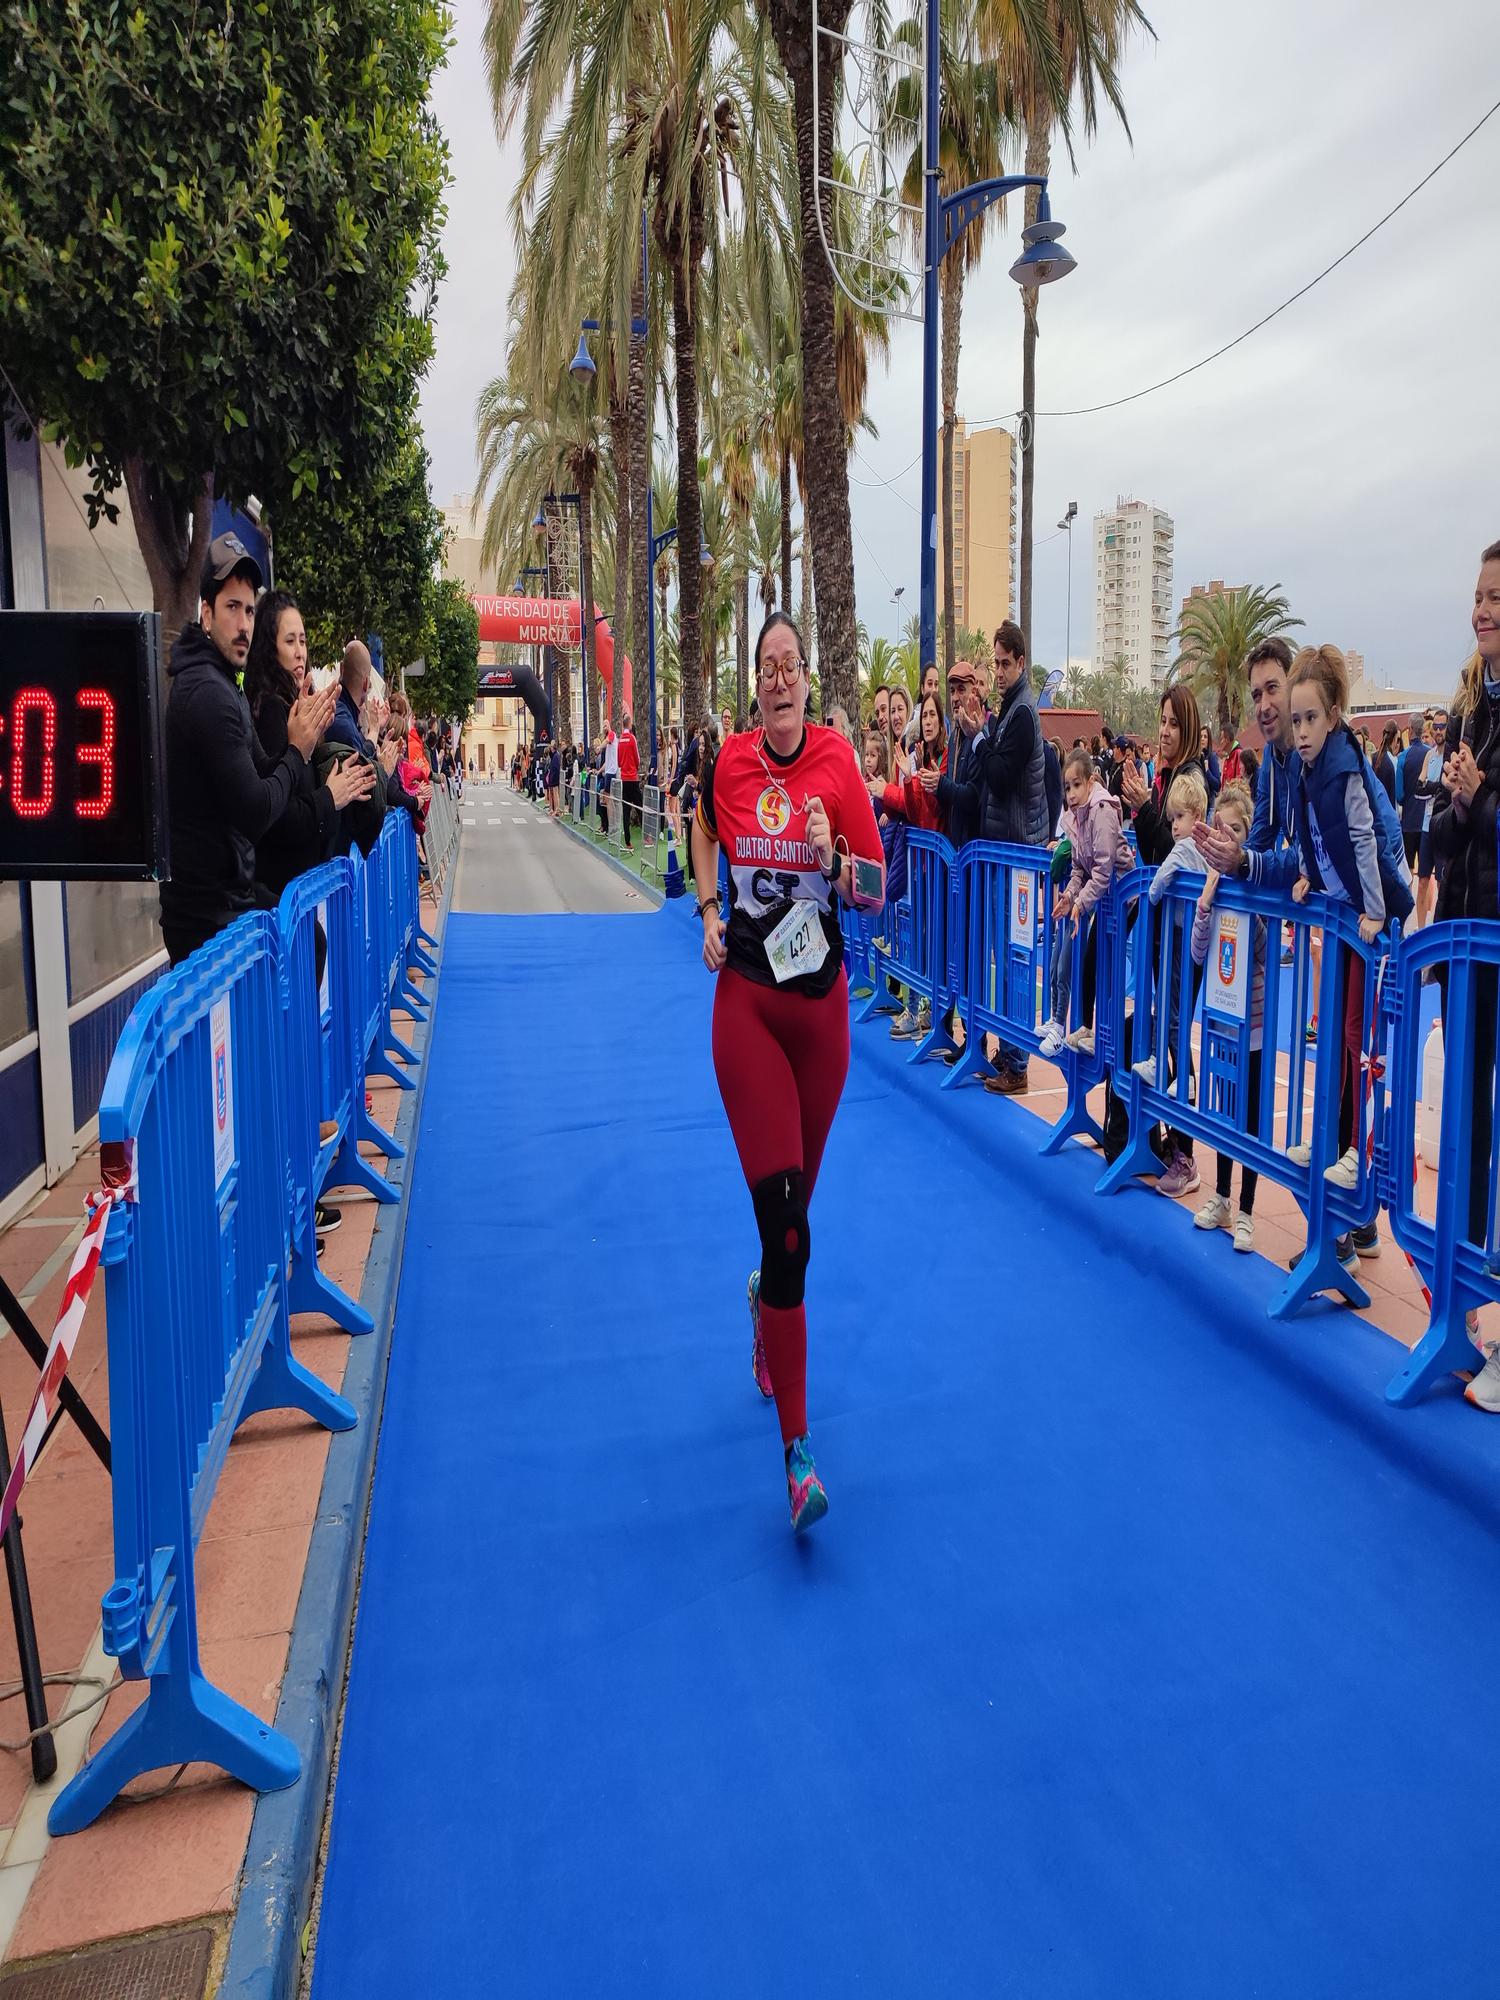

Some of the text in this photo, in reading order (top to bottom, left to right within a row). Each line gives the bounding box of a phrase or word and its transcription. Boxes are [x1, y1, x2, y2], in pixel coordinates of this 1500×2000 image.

[472, 599, 570, 620] NIVERSIDAD DE
[519, 624, 570, 642] MURCIA
[735, 836, 815, 865] CUATRO SANTOS
[790, 921, 811, 960] 427
